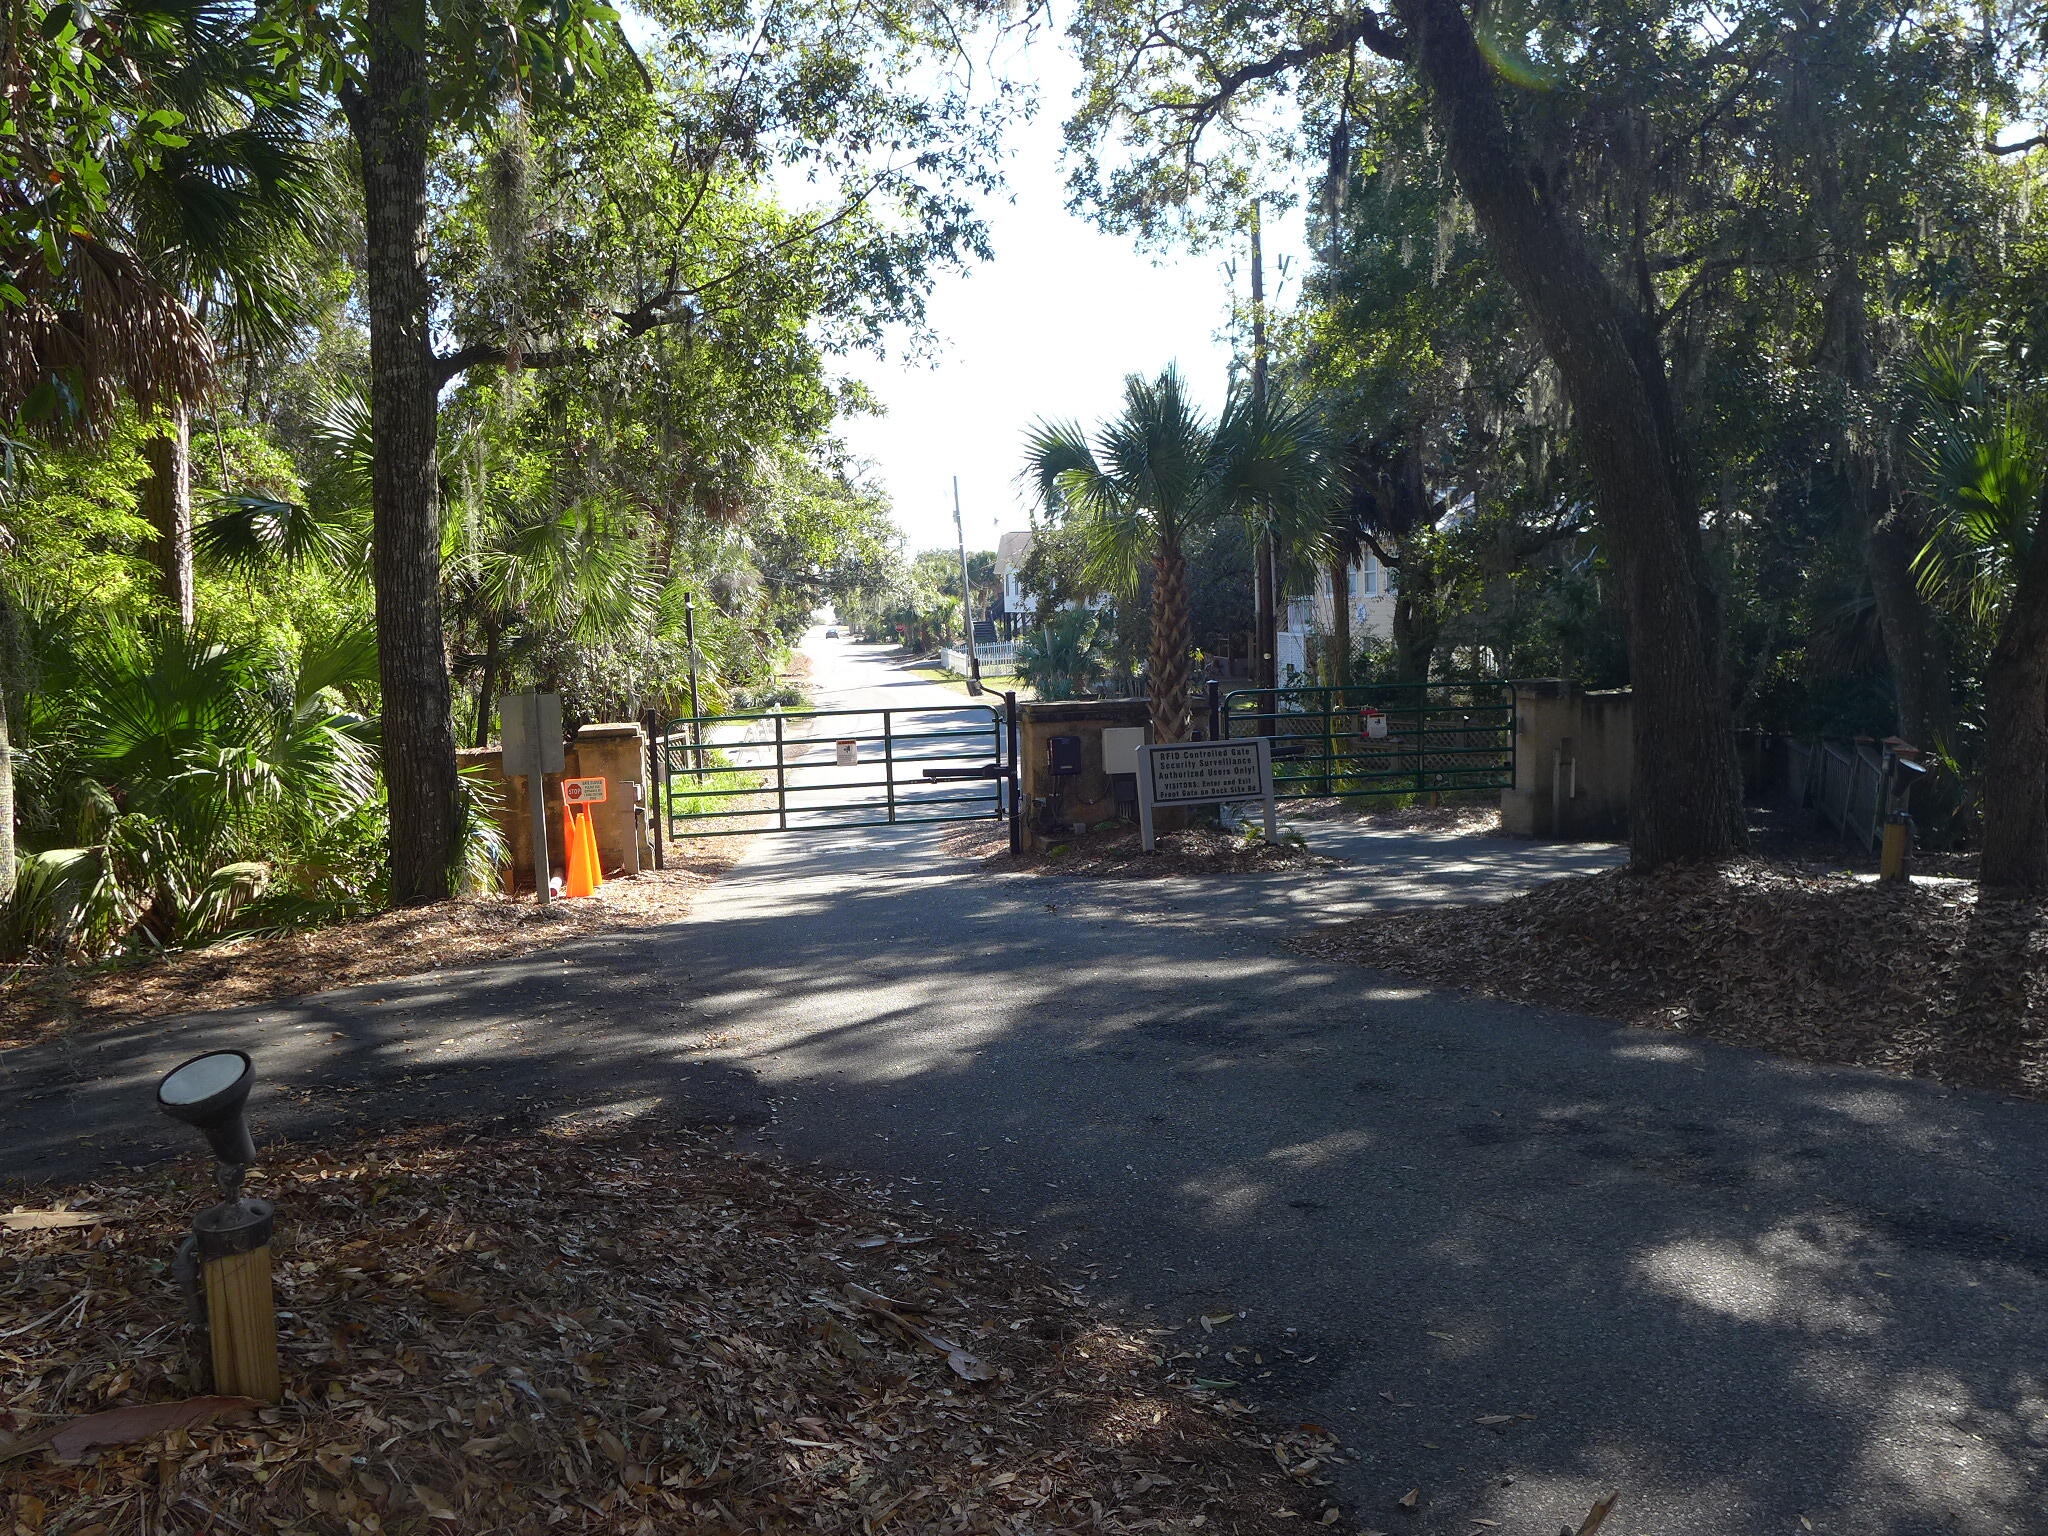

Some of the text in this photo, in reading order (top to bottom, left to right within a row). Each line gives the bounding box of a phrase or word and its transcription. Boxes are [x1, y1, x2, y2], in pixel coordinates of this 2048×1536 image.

[1160, 748, 1250, 761] RFID Controlled Gate
[1160, 758, 1252, 769] Security Surveillance
[1159, 766, 1255, 780] Authorized Users Only!
[1164, 781, 1200, 790] VISITORS:
[1202, 780, 1220, 788] Enter
